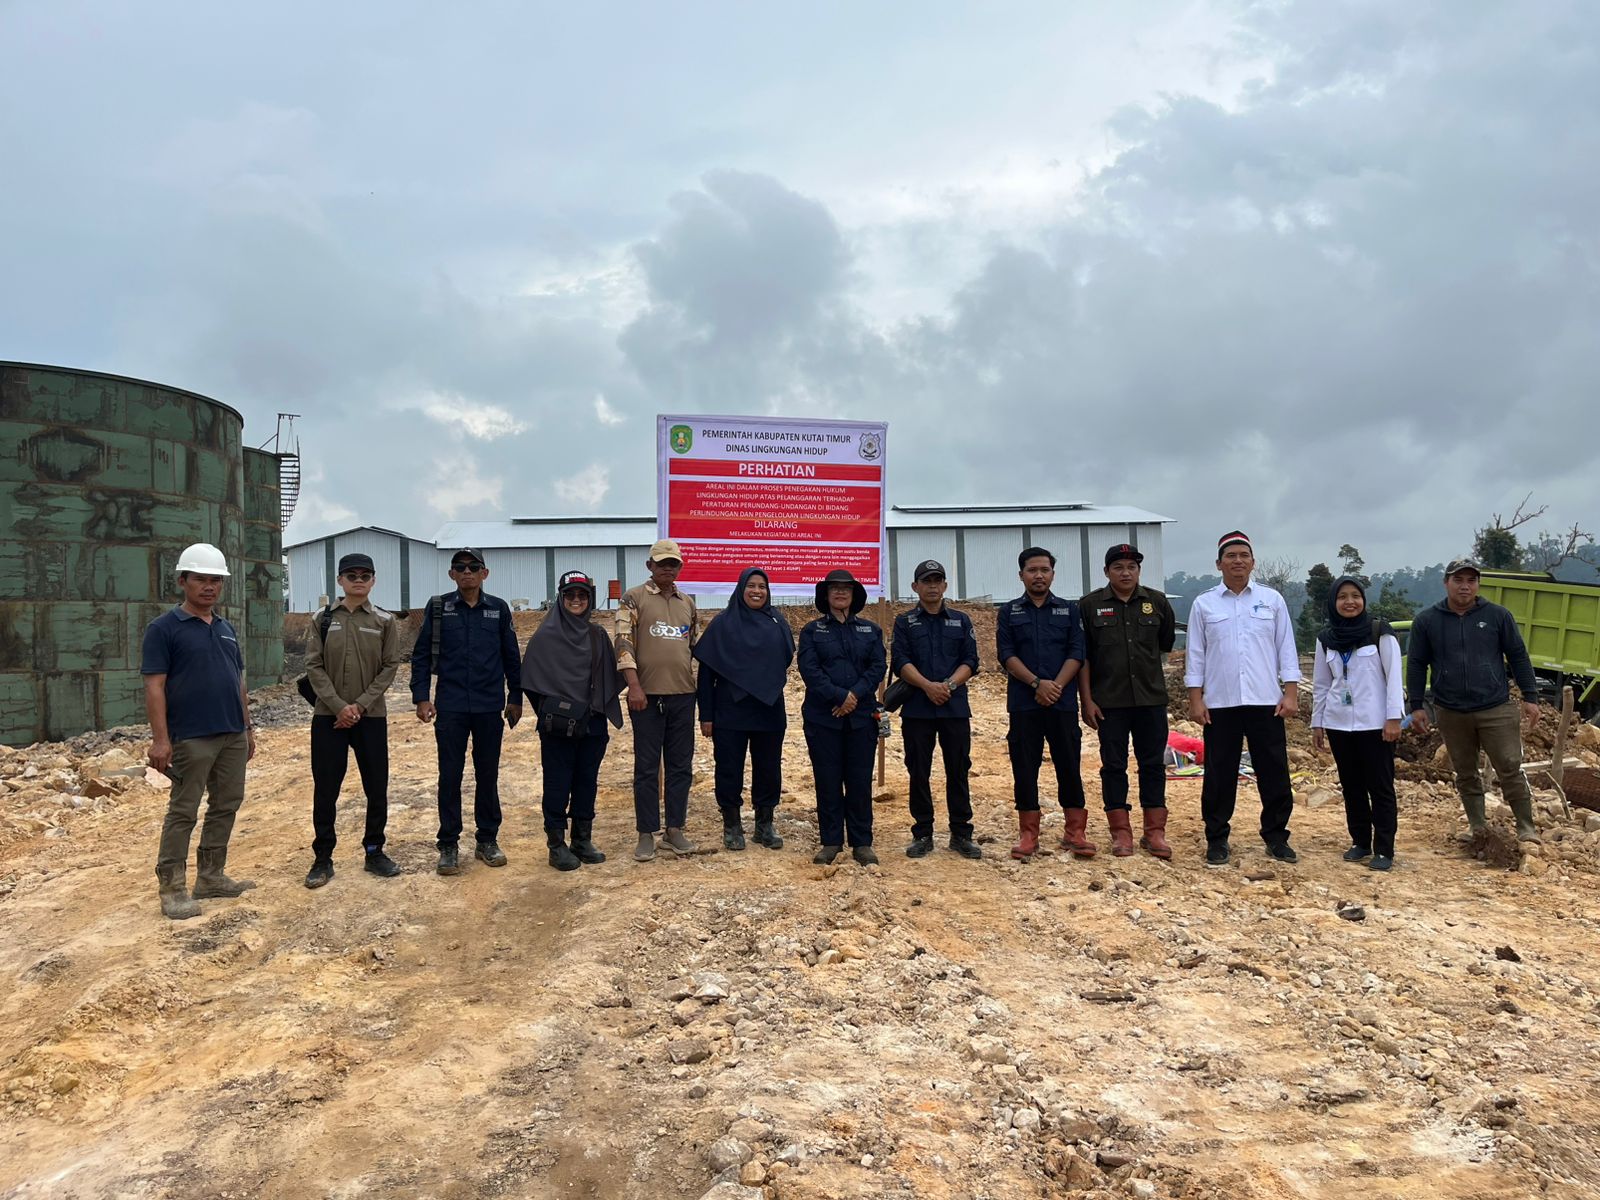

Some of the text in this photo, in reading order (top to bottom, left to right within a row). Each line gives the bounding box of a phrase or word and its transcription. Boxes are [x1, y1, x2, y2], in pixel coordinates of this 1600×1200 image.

[702, 429, 851, 443] PEMERINTAH KABUPATEN KUTAI TIMUR
[726, 444, 828, 456] DINAS LINGKUNGAN HIDUP
[738, 463, 816, 476] PERHATIAN
[754, 520, 798, 529] DILARANG
